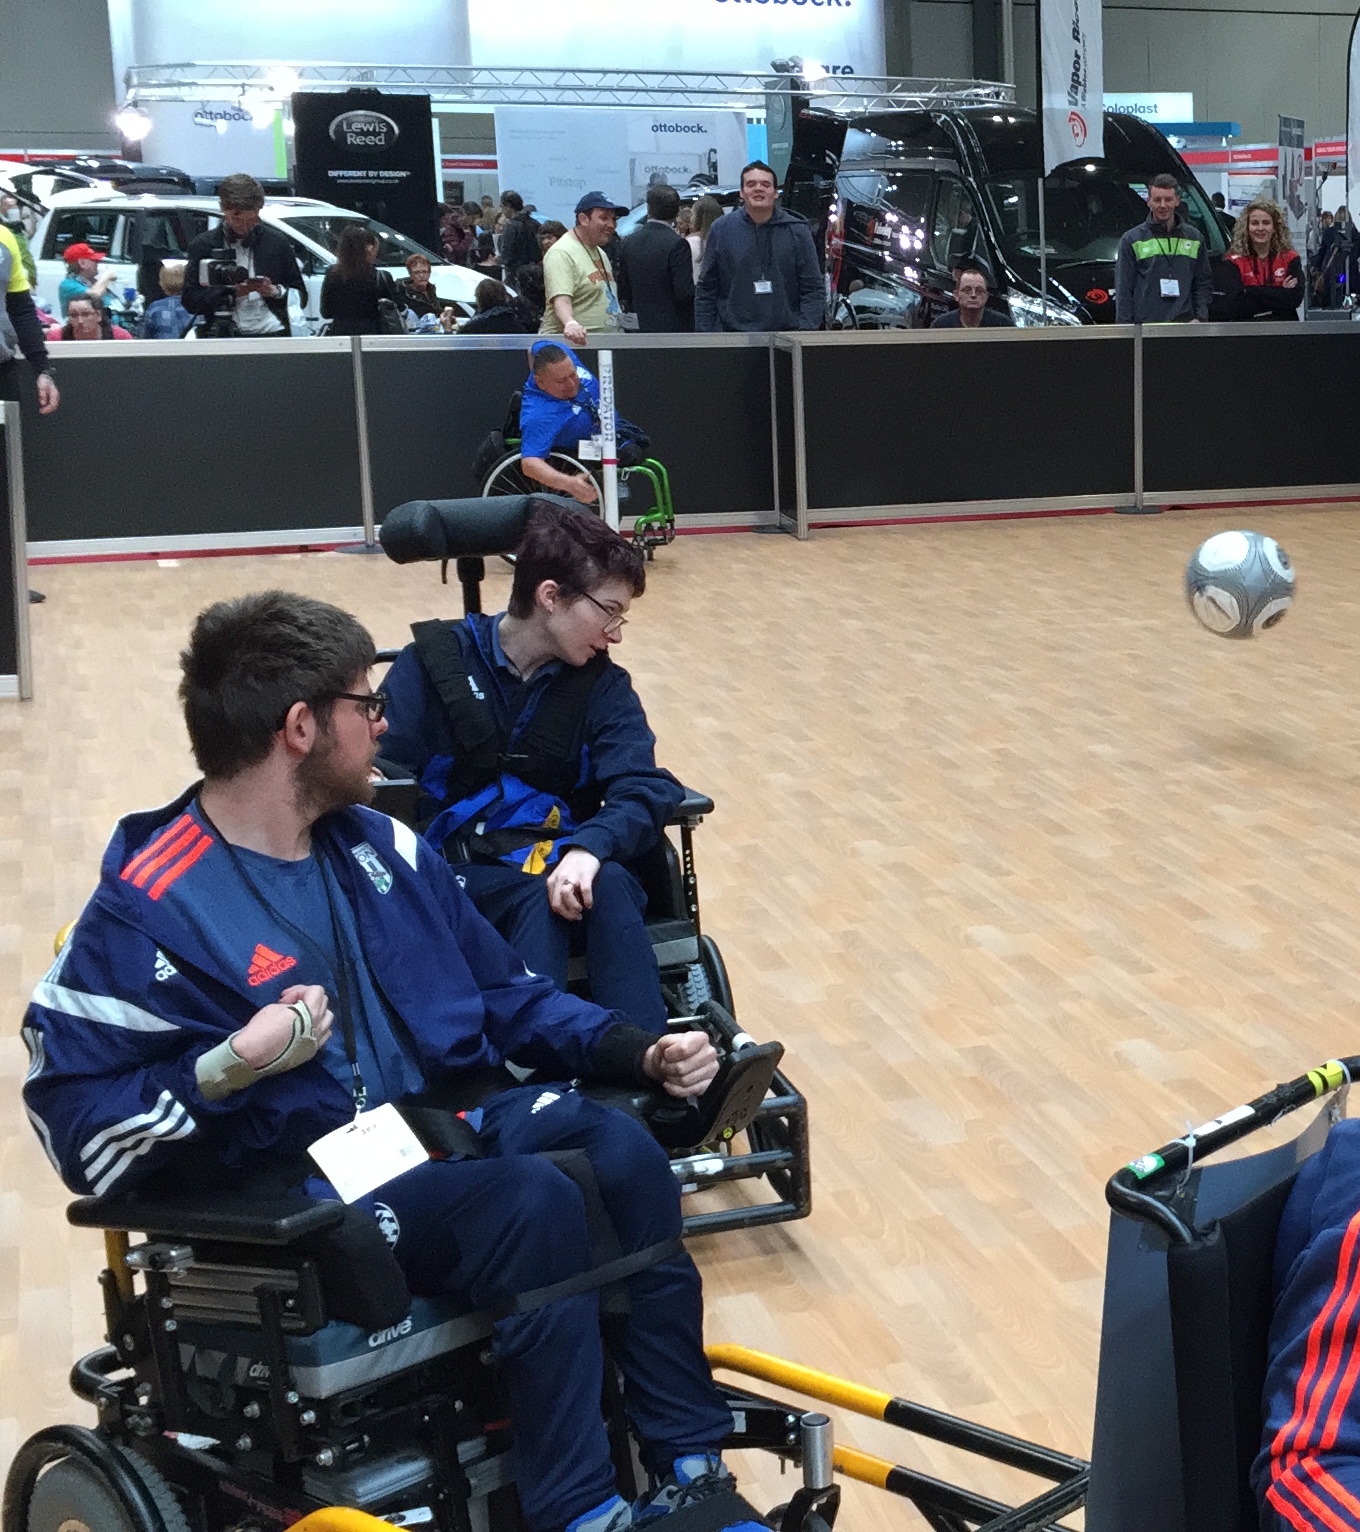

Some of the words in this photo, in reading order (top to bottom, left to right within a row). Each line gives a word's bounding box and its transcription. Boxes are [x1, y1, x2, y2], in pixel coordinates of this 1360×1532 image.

[1067, 50, 1083, 107] Vapor
[343, 119, 387, 133] Lewis
[651, 123, 708, 134] ottobock.
[347, 133, 385, 146] Reed
[549, 177, 586, 189] Pitstop
[600, 364, 614, 442] PREDATOR
[248, 956, 297, 987] adidas
[368, 1316, 411, 1348] drive
